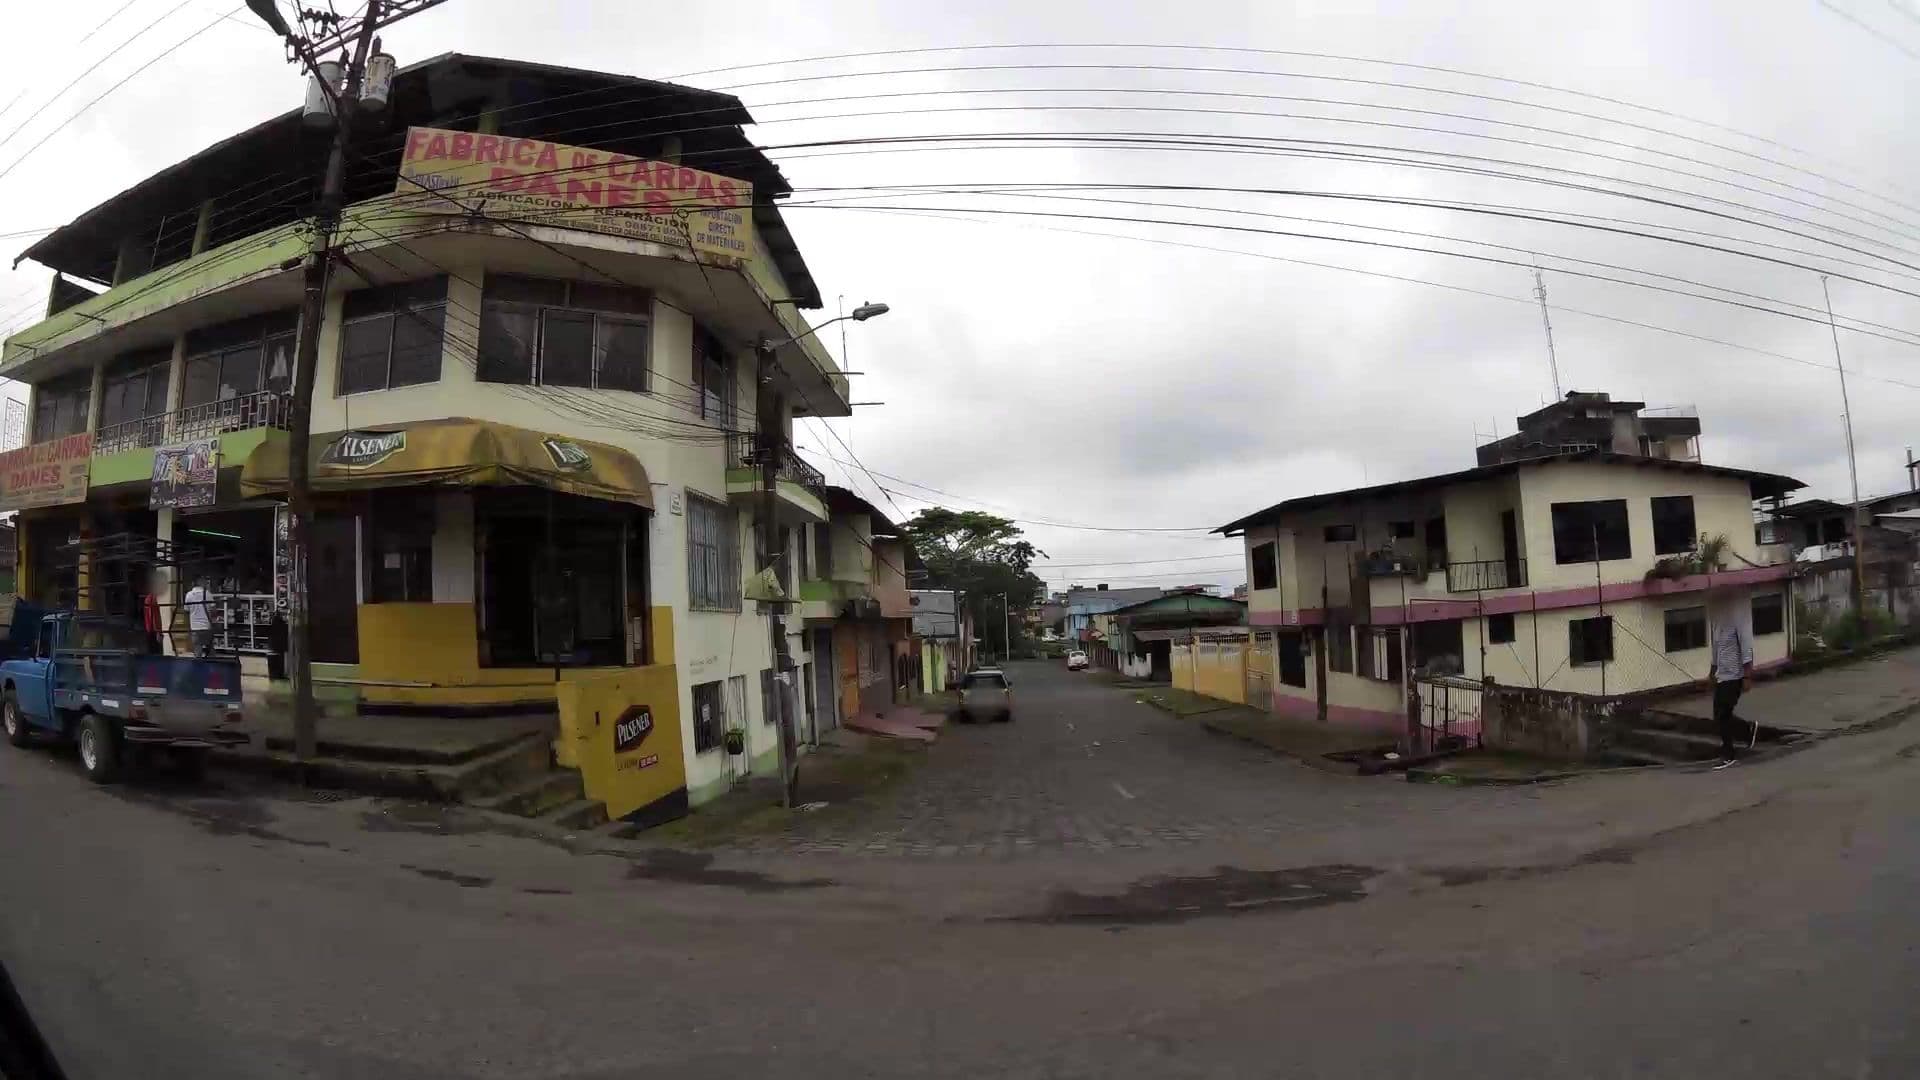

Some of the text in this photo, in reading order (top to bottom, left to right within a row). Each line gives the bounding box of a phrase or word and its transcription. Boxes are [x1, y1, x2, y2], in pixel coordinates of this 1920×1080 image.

[406, 130, 737, 206] FABRICA DE CARPAS
[467, 190, 573, 209] FABRICACION
[616, 712, 650, 745] PILSENER
